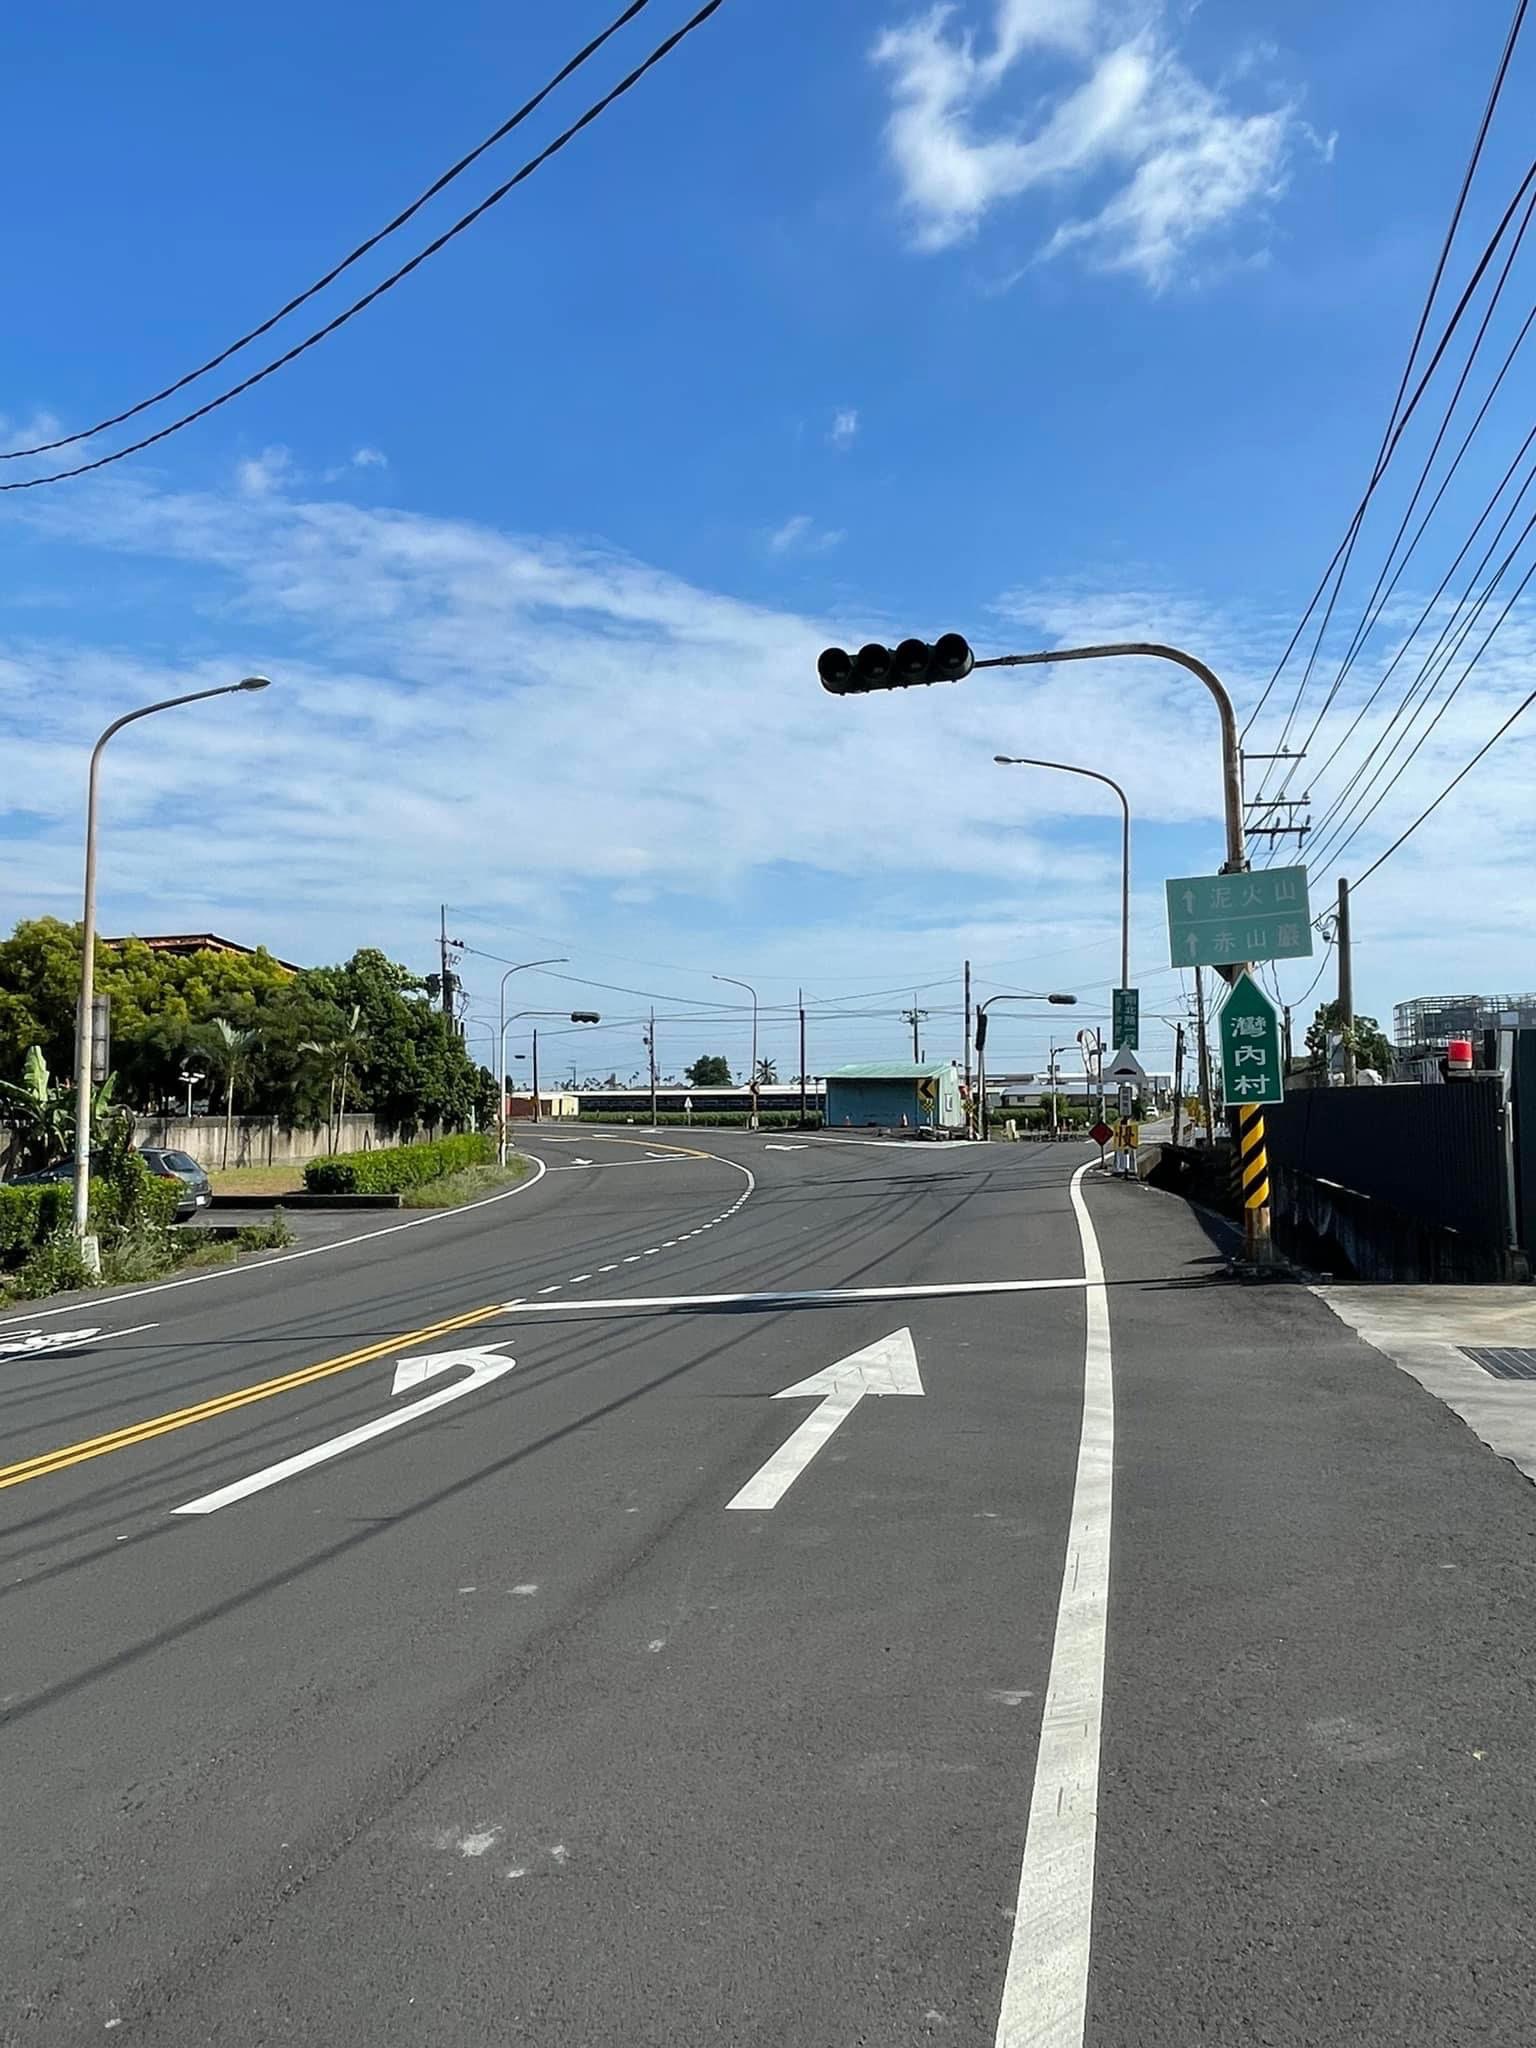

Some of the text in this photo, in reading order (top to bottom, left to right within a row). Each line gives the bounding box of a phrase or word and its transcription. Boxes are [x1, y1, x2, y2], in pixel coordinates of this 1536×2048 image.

[1210, 880, 1297, 909] 泥火山
[1230, 1016, 1270, 1095] 灣內村
